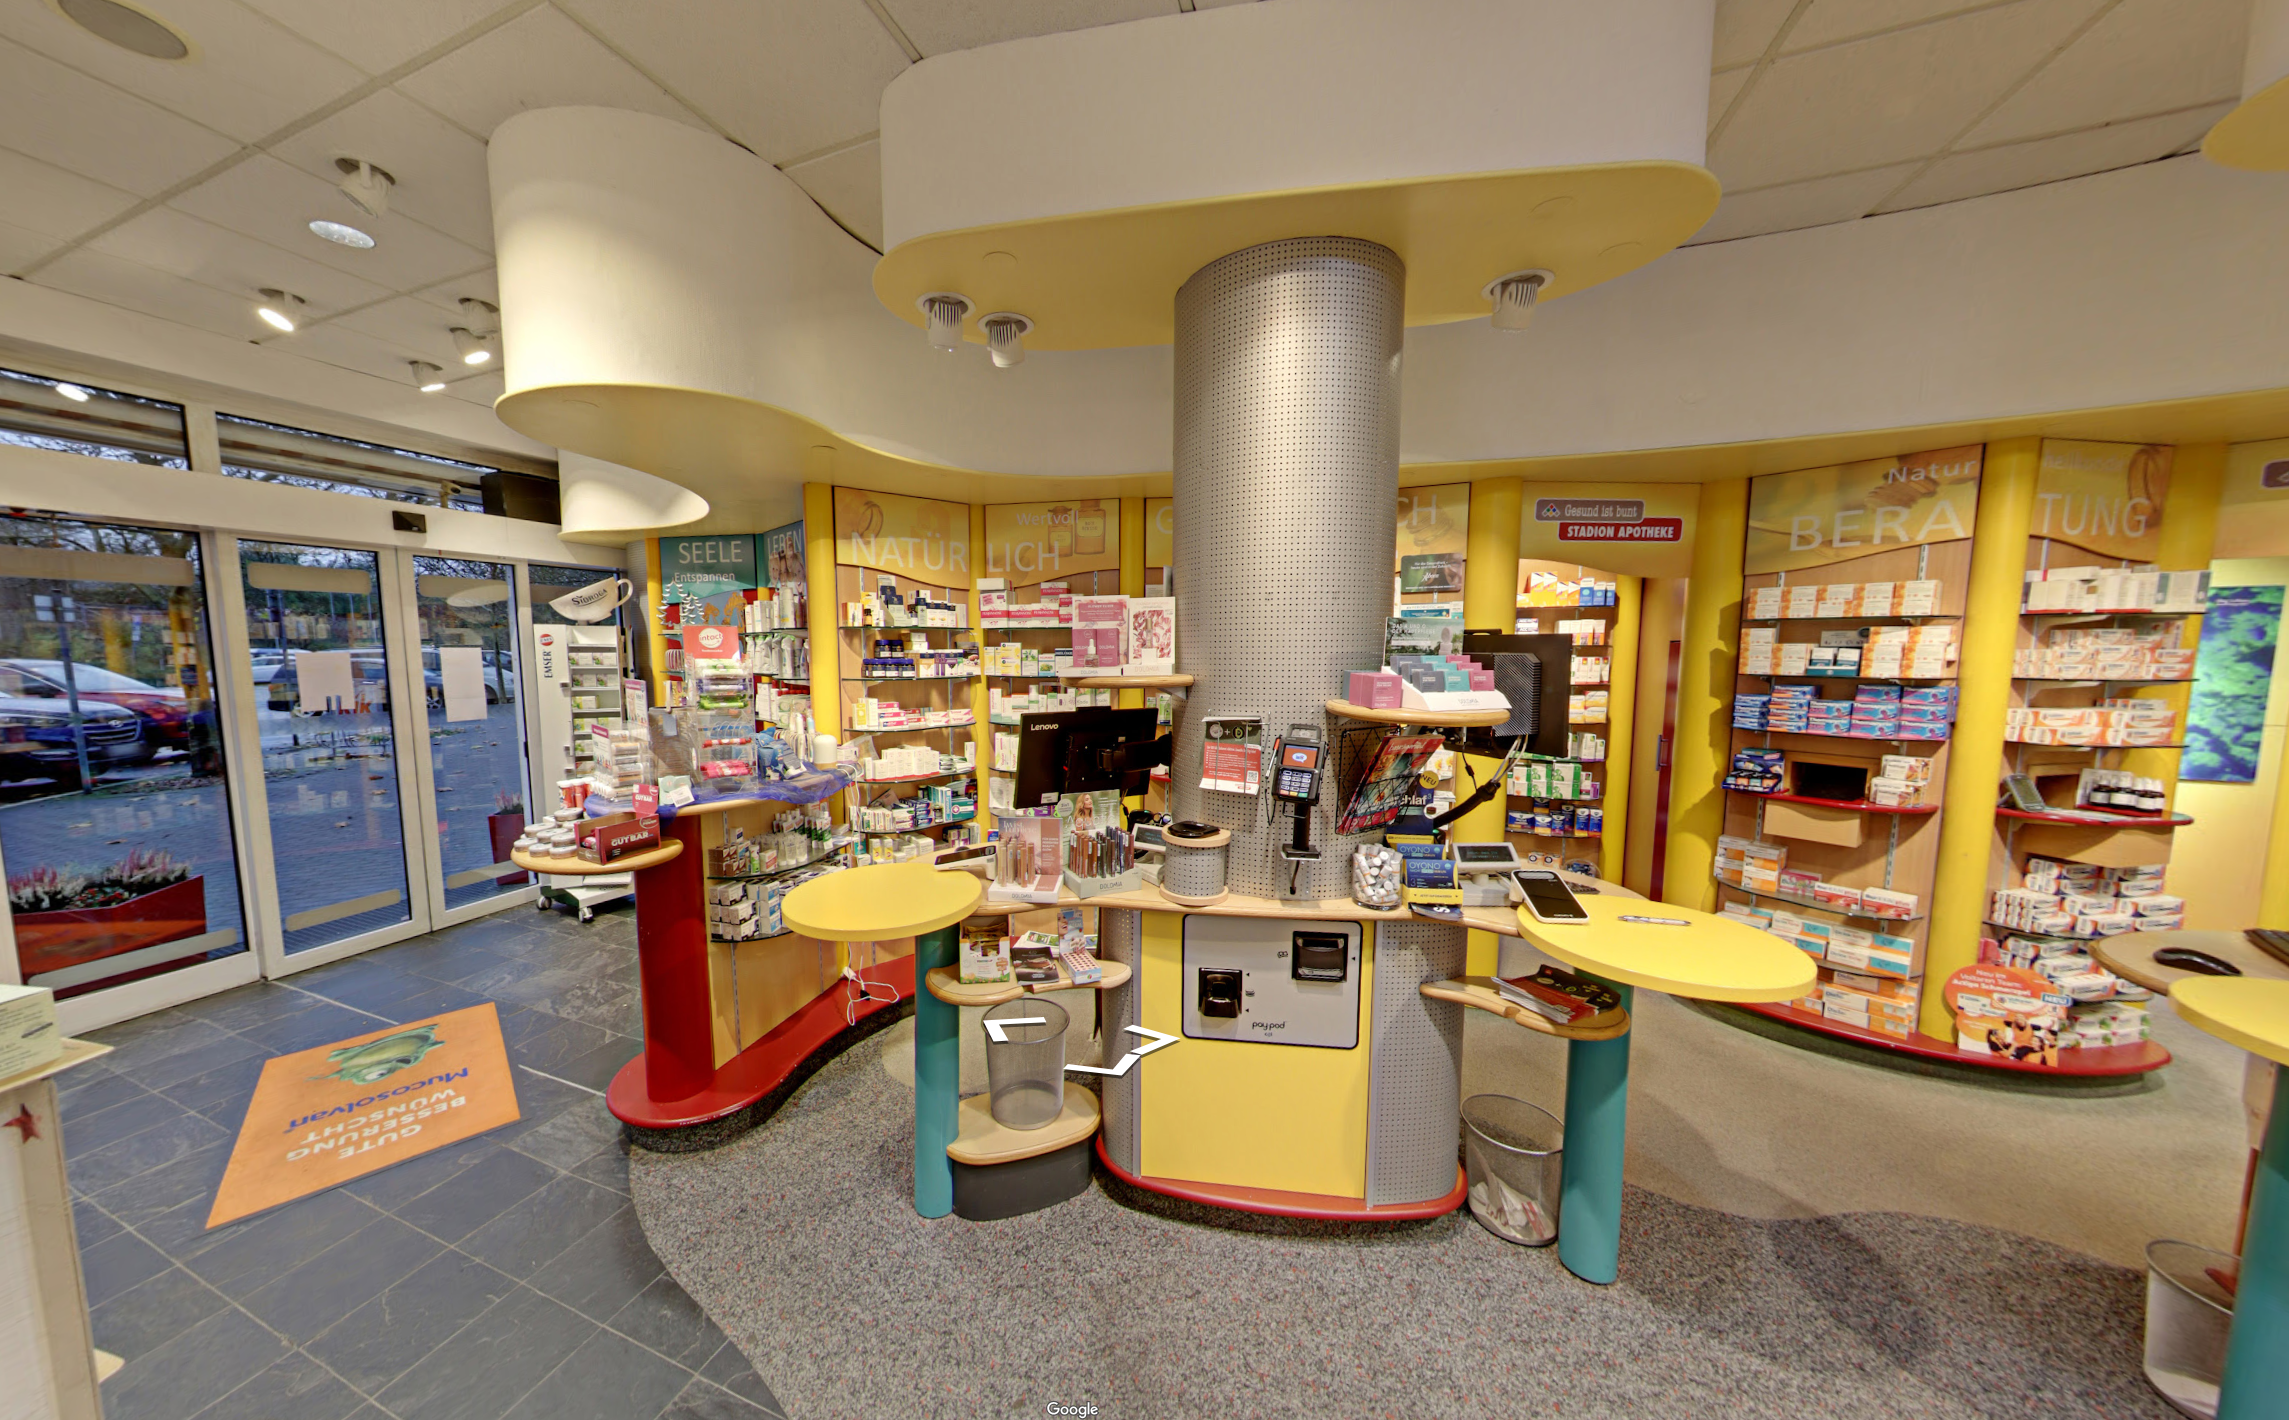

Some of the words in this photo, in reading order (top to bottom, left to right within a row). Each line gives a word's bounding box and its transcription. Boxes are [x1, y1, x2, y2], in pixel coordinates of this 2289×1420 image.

[1888, 460, 1977, 484] Natur
[1016, 509, 1079, 526] Wertvoll
[1564, 504, 1599, 518] Gesund
[1601, 505, 1613, 518] ist
[1616, 505, 1638, 518] bunt
[2038, 493, 2150, 538] TUNG
[1567, 525, 1615, 538] STADION
[1617, 526, 1675, 539] APOTHEKE
[1789, 499, 1967, 552] BERA
[678, 540, 743, 564] SEELE
[767, 528, 803, 558] LEBEN
[851, 531, 968, 573] NATÜR
[988, 541, 1060, 573] LICH
[674, 572, 735, 584] Entspannen
[699, 631, 723, 642] intact
[543, 651, 554, 678] EMSER
[1031, 723, 1059, 731] Lenovo
[1421, 774, 1437, 786] NEU
[1400, 845, 1431, 853] OYONO
[1409, 861, 1441, 869] OYONO
[290, 1067, 469, 1131] Mucosolvan
[300, 1088, 456, 1145] WÜNSCHT
[286, 1096, 467, 1162] BESSERUNG
[338, 1124, 423, 1160] GUTE
